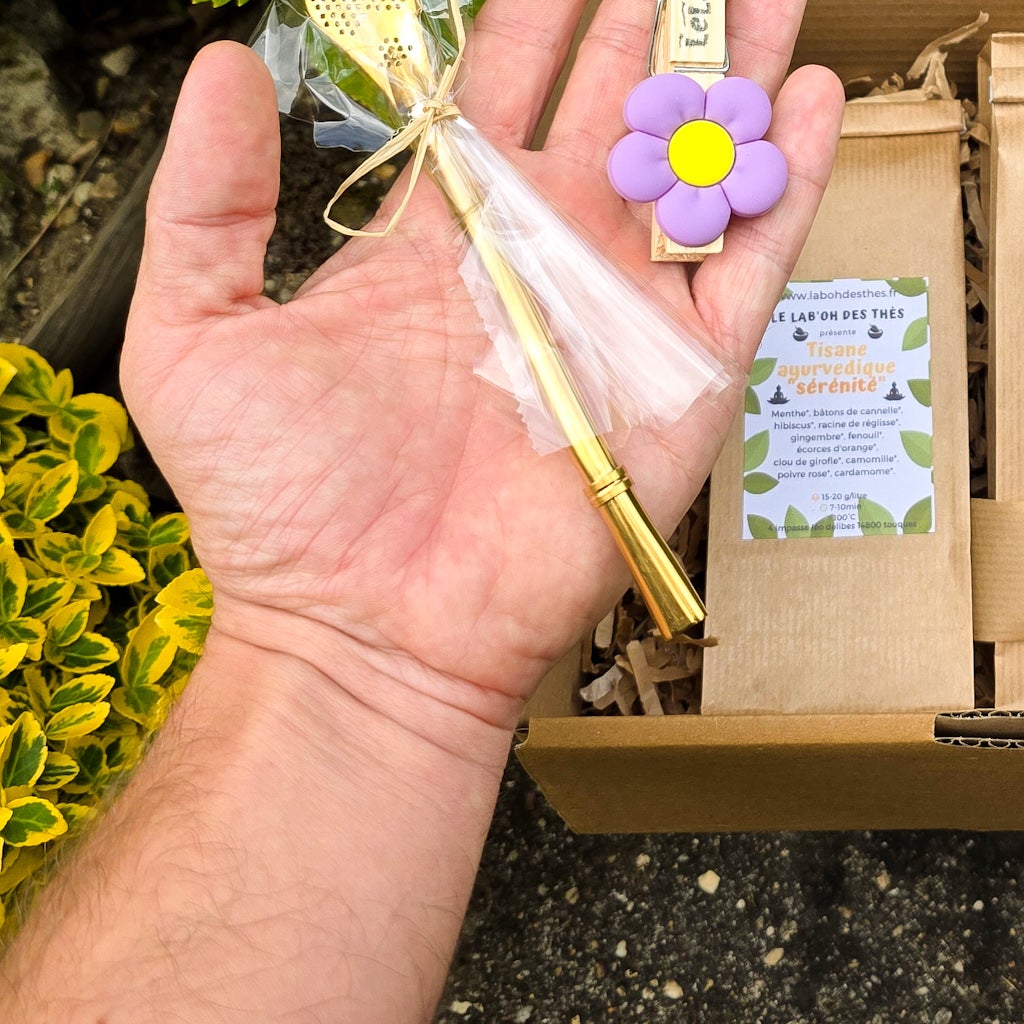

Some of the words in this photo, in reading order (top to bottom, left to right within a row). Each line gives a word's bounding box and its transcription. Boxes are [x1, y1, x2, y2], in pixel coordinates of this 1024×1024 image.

[771, 312, 786, 323] LE
[791, 311, 838, 323] LAB'OH
[843, 309, 867, 321] DES
[819, 328, 857, 337] présente
[806, 341, 868, 358] Tisane
[777, 360, 896, 380] ayurvedique
[813, 408, 844, 417] bâtons
[847, 407, 858, 416] de
[818, 420, 846, 429] racine
[848, 419, 860, 427] de
[797, 445, 831, 454] écorces
[773, 458, 793, 466] clou
[795, 457, 807, 466] de
[777, 470, 806, 480] poivre
[821, 493, 843, 501] 15-20
